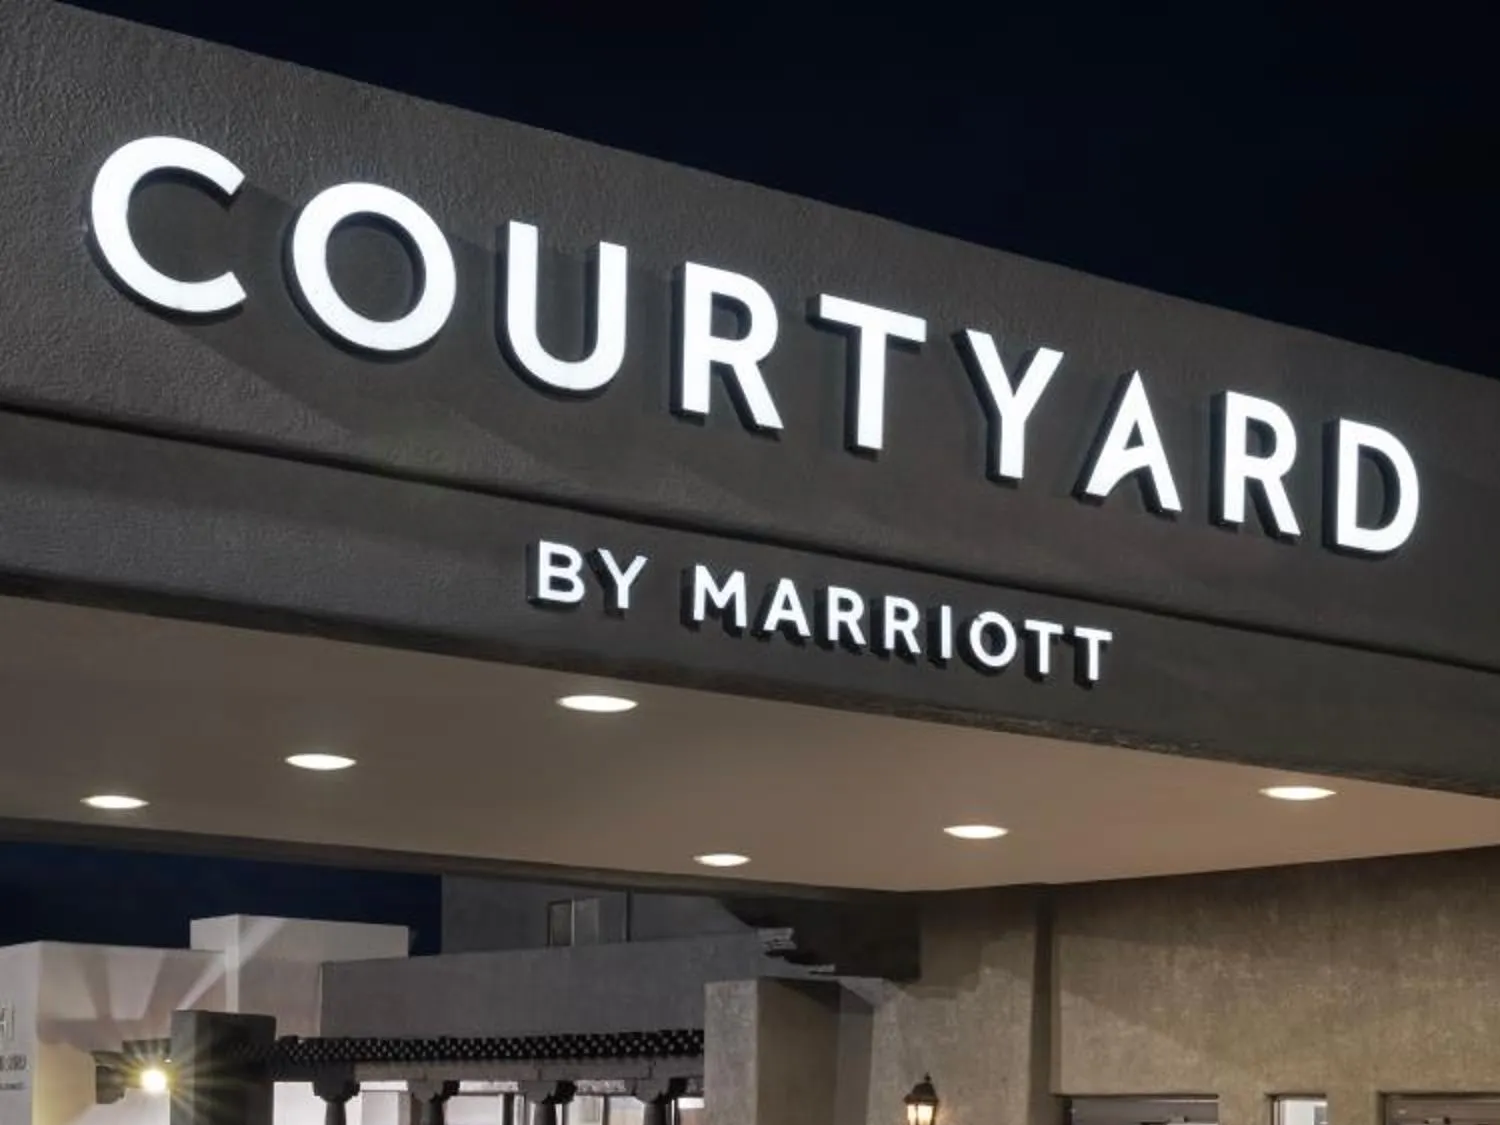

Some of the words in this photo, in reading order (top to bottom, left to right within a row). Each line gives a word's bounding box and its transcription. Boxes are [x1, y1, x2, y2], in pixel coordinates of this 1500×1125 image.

[90, 135, 1421, 554] COURTYARD
[535, 539, 649, 610] BY
[690, 563, 1114, 683] MARRIOTT
